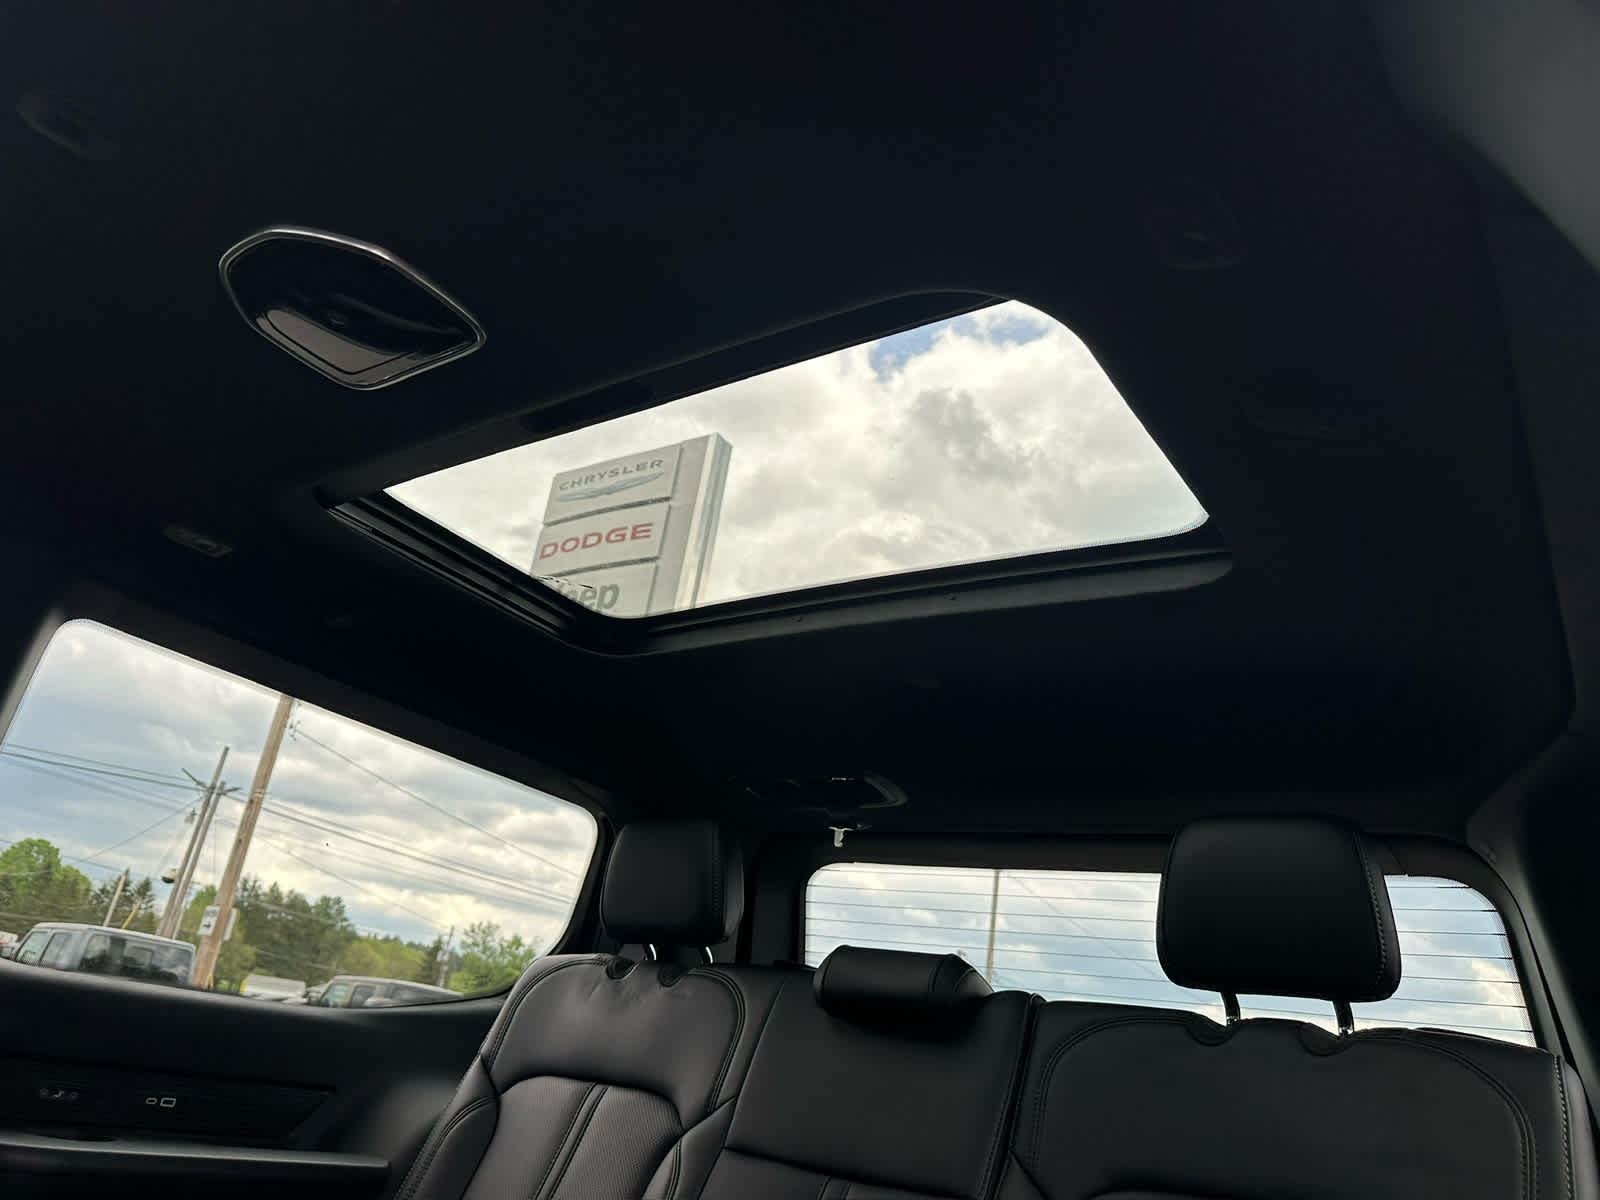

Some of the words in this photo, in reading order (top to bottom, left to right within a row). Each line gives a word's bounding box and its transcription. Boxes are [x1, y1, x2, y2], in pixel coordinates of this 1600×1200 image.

[559, 459, 664, 491] CHRYSLER
[539, 522, 653, 559] DODGE
[558, 583, 620, 610] ep
